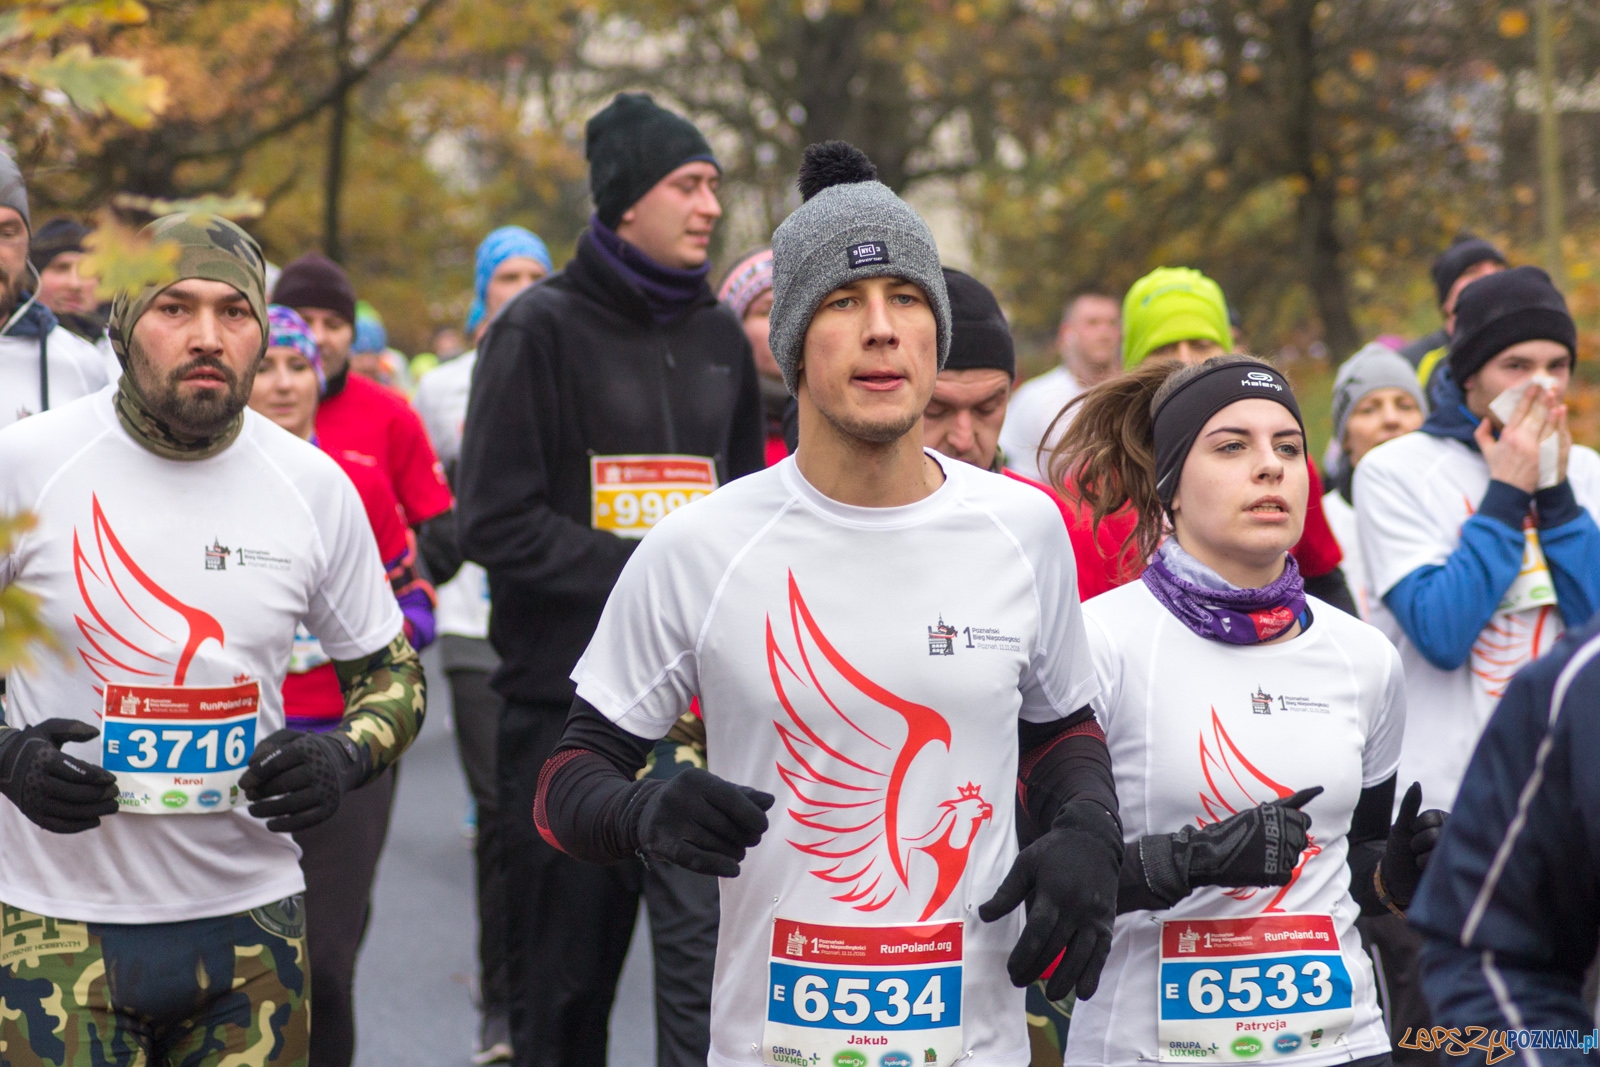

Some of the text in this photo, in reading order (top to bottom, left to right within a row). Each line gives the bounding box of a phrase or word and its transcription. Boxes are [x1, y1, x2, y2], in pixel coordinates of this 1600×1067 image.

[1241, 380, 1283, 392] Kalenji
[236, 547, 246, 566] 1
[963, 626, 975, 648] 1
[973, 634, 986, 642] Bieg
[143, 697, 151, 712] 1
[200, 697, 252, 711] RunPoland.org
[1277, 695, 1288, 711] 1
[107, 739, 120, 754] E
[126, 726, 246, 769] 3716
[174, 777, 204, 785] Karol
[1203, 932, 1212, 948] 1
[1264, 929, 1329, 942] RunPoland.org
[811, 937, 820, 954] 1
[880, 941, 952, 954] RunPoland.org
[1165, 961, 1333, 1014] E 6533
[773, 974, 945, 1025] E 6534
[1236, 1019, 1287, 1032] Patrycja
[847, 1035, 888, 1045] Jakub
[1169, 1041, 1201, 1049] GRUPA
[772, 1046, 802, 1058] GRUPA
[1169, 1049, 1207, 1057] LUXMED
[773, 1054, 808, 1067] LUXMED
